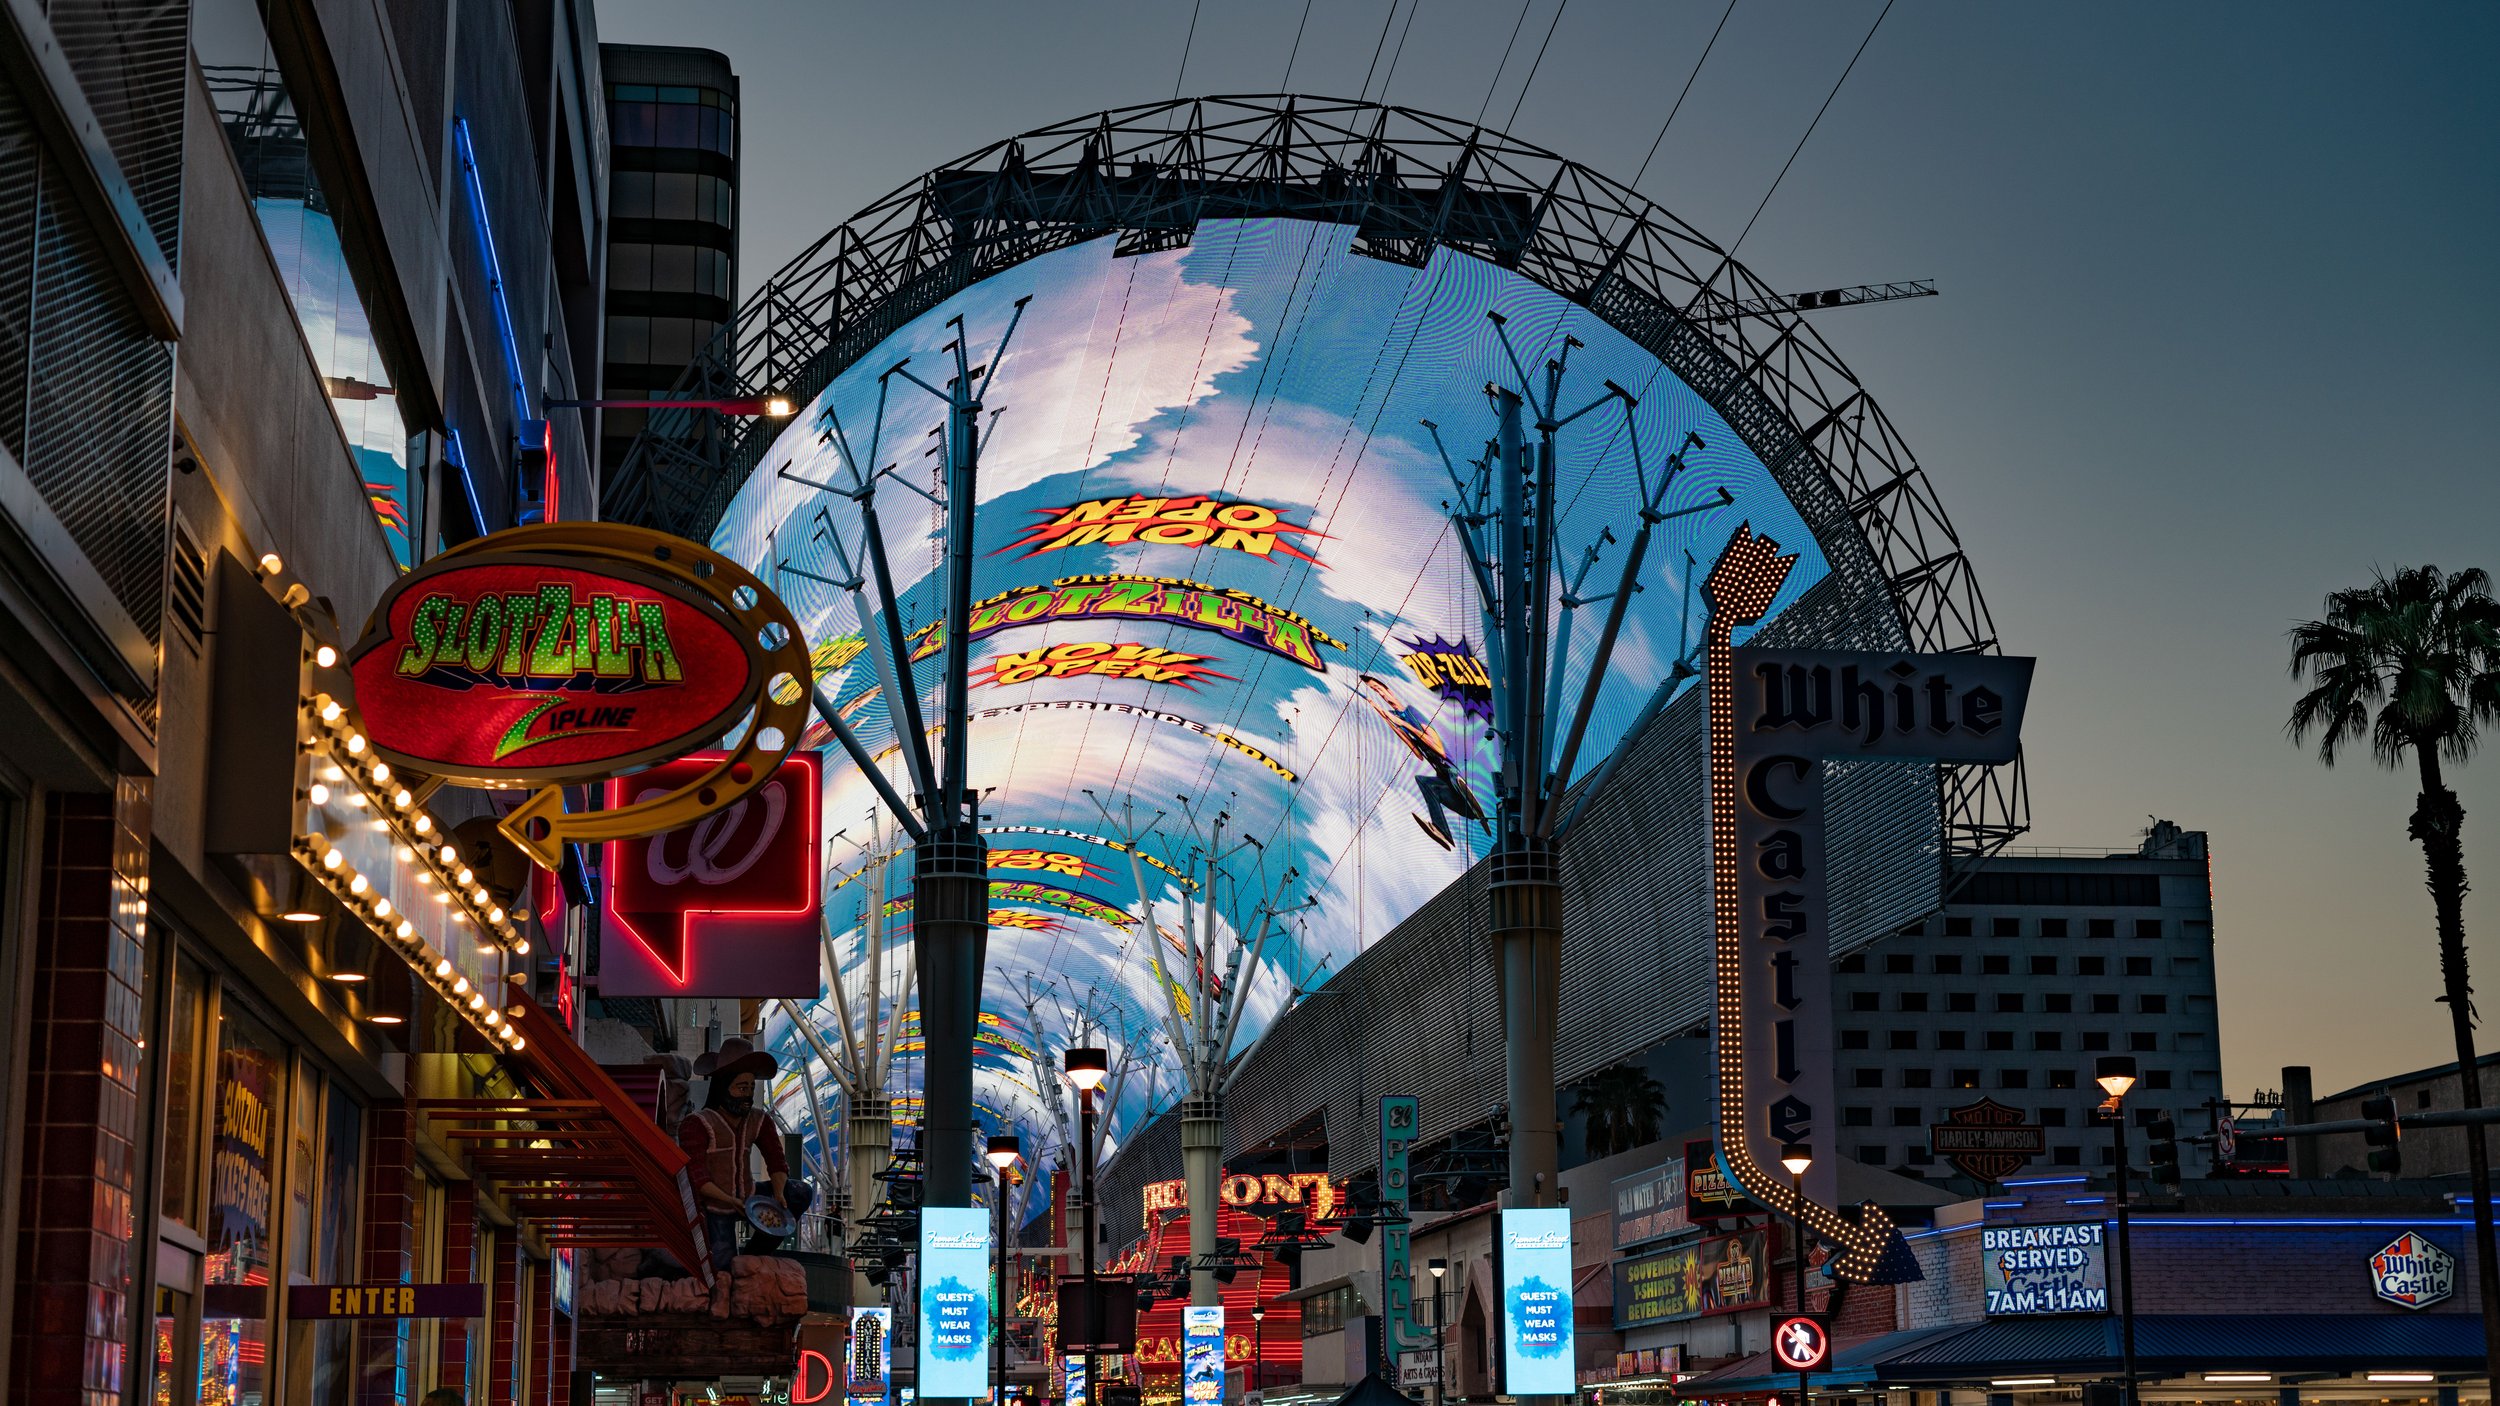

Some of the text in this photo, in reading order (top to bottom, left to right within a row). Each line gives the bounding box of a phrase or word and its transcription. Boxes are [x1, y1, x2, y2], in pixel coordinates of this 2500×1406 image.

[1050, 498, 1278, 529] OPEN
[1039, 523, 1277, 555] NOW
[1052, 573, 1216, 592] Ultimate
[1226, 588, 1348, 652] Zipline
[393, 581, 686, 686] SLOTZILLA
[994, 642, 1202, 673] NOW
[998, 659, 1190, 685] OPEN
[1754, 660, 2003, 746] White
[1744, 755, 1813, 1145] Castle
[223, 1079, 268, 1160] SLOTZILLA
[1388, 1105, 1412, 1128] El
[1939, 1130, 2038, 1149] HARLEY-DAVIDSON
[214, 1150, 249, 1213] TICKETS
[246, 1165, 270, 1234] HERE
[1694, 1173, 1734, 1191] PIZZ
[1633, 1183, 1655, 1211] WATER
[1983, 1225, 2103, 1250] BREAKFAST
[1628, 1256, 1682, 1282] SOUVENIRS
[2003, 1247, 2083, 1270] SERVED
[2383, 1254, 2444, 1278] White
[1520, 1292, 1558, 1301] GUESTS
[1634, 1277, 1676, 1301] T-SHIRTS
[2380, 1275, 2448, 1294] Castle
[329, 1287, 415, 1315] ENTER
[936, 1293, 974, 1302] GUESTS
[1628, 1296, 1684, 1321] BEVERAGES
[1987, 1287, 2106, 1313] 7AM-11AM
[942, 1307, 968, 1316] MUST
[1526, 1306, 1552, 1315] MUST
[939, 1321, 970, 1329] WEAR
[1524, 1319, 1555, 1328] WEAR
[864, 1320, 873, 1379] AMERICAN
[938, 1335, 972, 1344] MASKS
[1523, 1333, 1557, 1342] MASKS
[1193, 1381, 1217, 1392] NOW
[1193, 1391, 1217, 1401] OPEN
